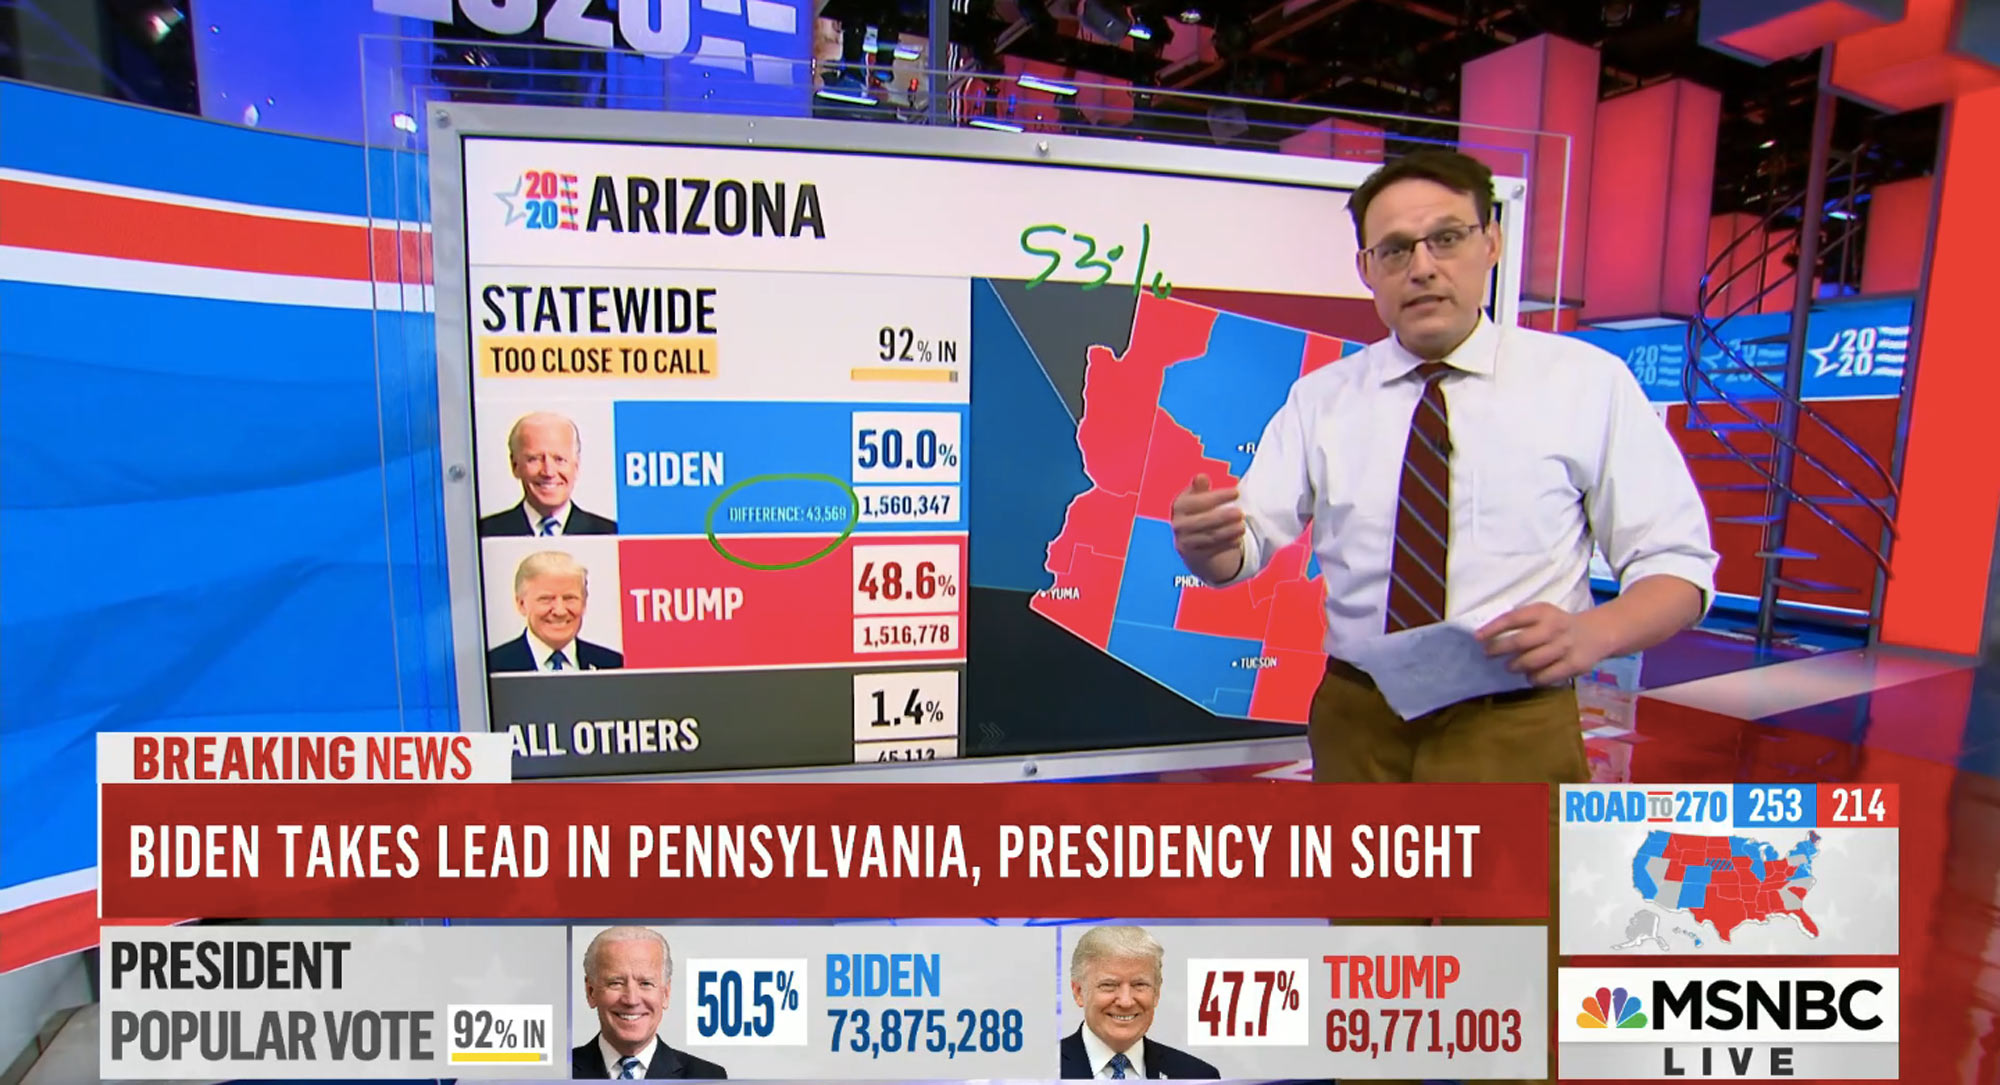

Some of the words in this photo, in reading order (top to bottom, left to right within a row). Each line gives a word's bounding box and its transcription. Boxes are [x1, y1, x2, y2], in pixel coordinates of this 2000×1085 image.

[525, 170, 558, 199] 20
[525, 199, 559, 230] 20
[586, 175, 826, 240] ARIZONA
[482, 284, 718, 335] STATEWIDE
[879, 326, 932, 362] 92%
[938, 340, 957, 363] IN
[1839, 327, 1877, 353] 20
[491, 346, 535, 373] TOO
[542, 347, 612, 374] CLOSE
[622, 348, 650, 374] TO
[654, 348, 711, 375] CALL
[1836, 351, 1874, 377] 20
[858, 429, 958, 469] 50.0%
[625, 451, 725, 488] BIDEN
[729, 505, 804, 523] DIFFERENCE:
[806, 504, 847, 524] 43,569
[863, 494, 950, 517] 1,560,347
[857, 561, 957, 601] 48.6%
[1050, 585, 1080, 601] YUMA
[630, 586, 744, 623] TRUMP
[863, 624, 950, 648] 1,516,778
[1240, 656, 1277, 669] TUCSON
[870, 688, 945, 728] 1.4%
[508, 723, 566, 758] ALL
[573, 717, 700, 755] OTHERS
